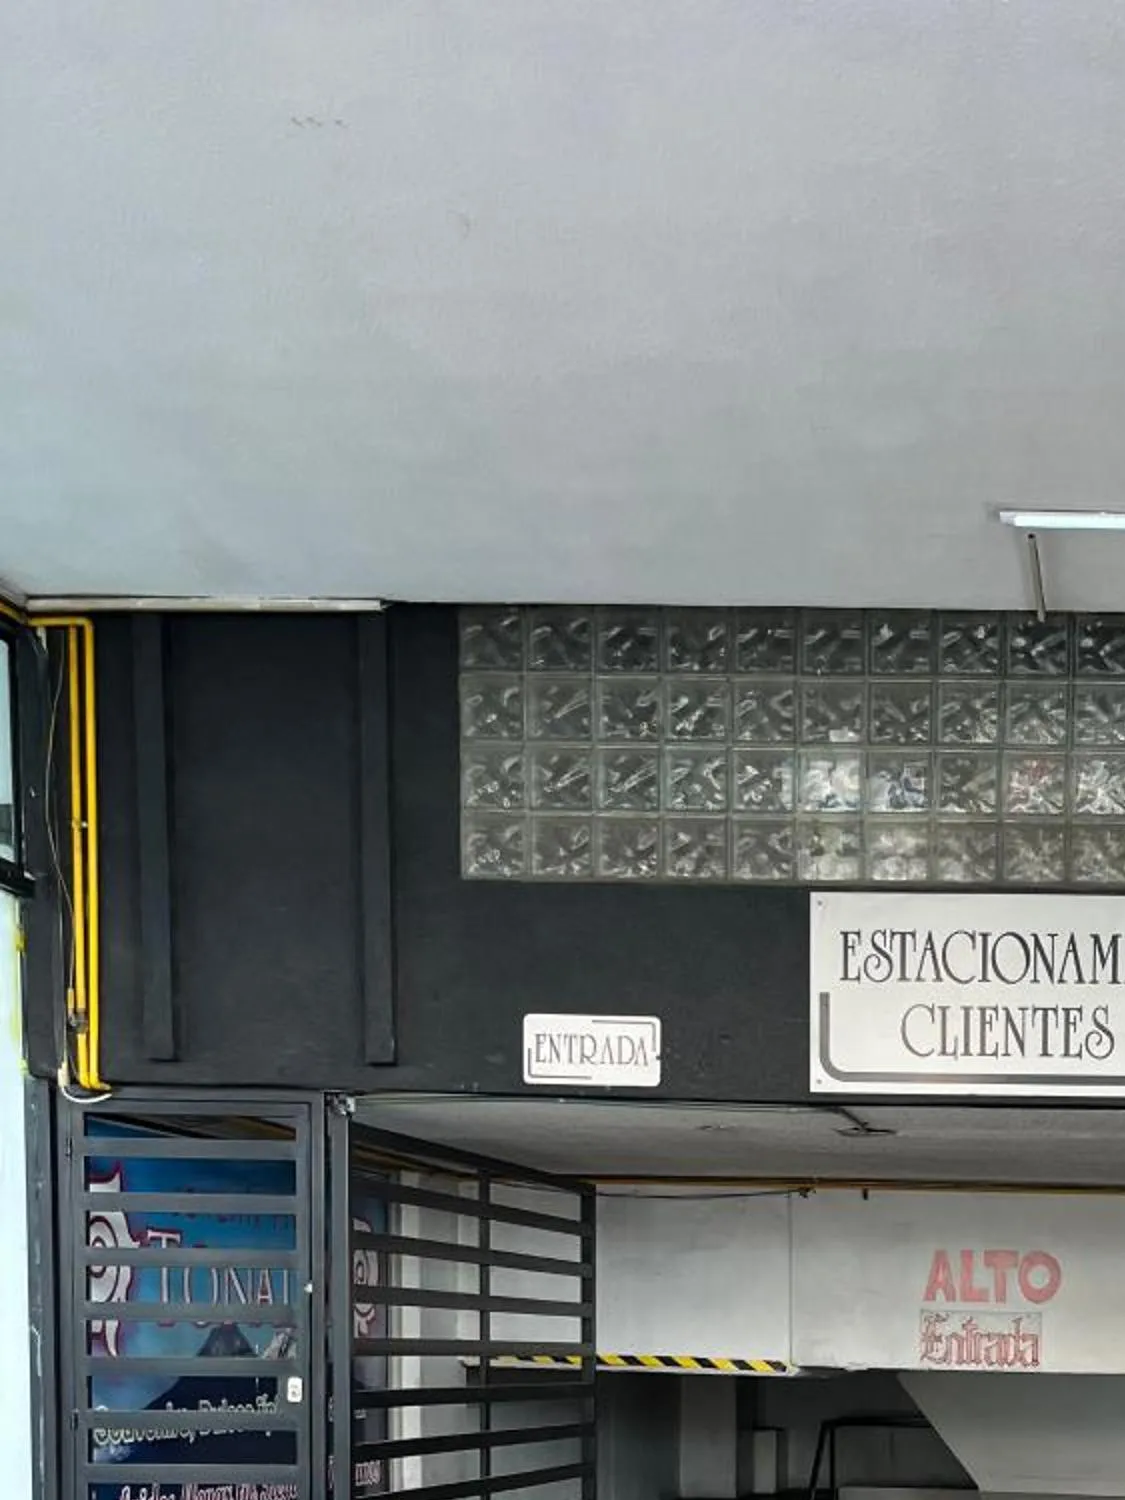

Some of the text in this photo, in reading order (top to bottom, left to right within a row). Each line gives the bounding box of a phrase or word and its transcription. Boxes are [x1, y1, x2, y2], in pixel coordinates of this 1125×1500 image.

[534, 1033, 649, 1067] ENTRADA
[900, 1004, 1115, 1060] CLIENTES
[922, 1249, 1062, 1304] ALTO
[920, 1311, 1041, 1368] Entrada
